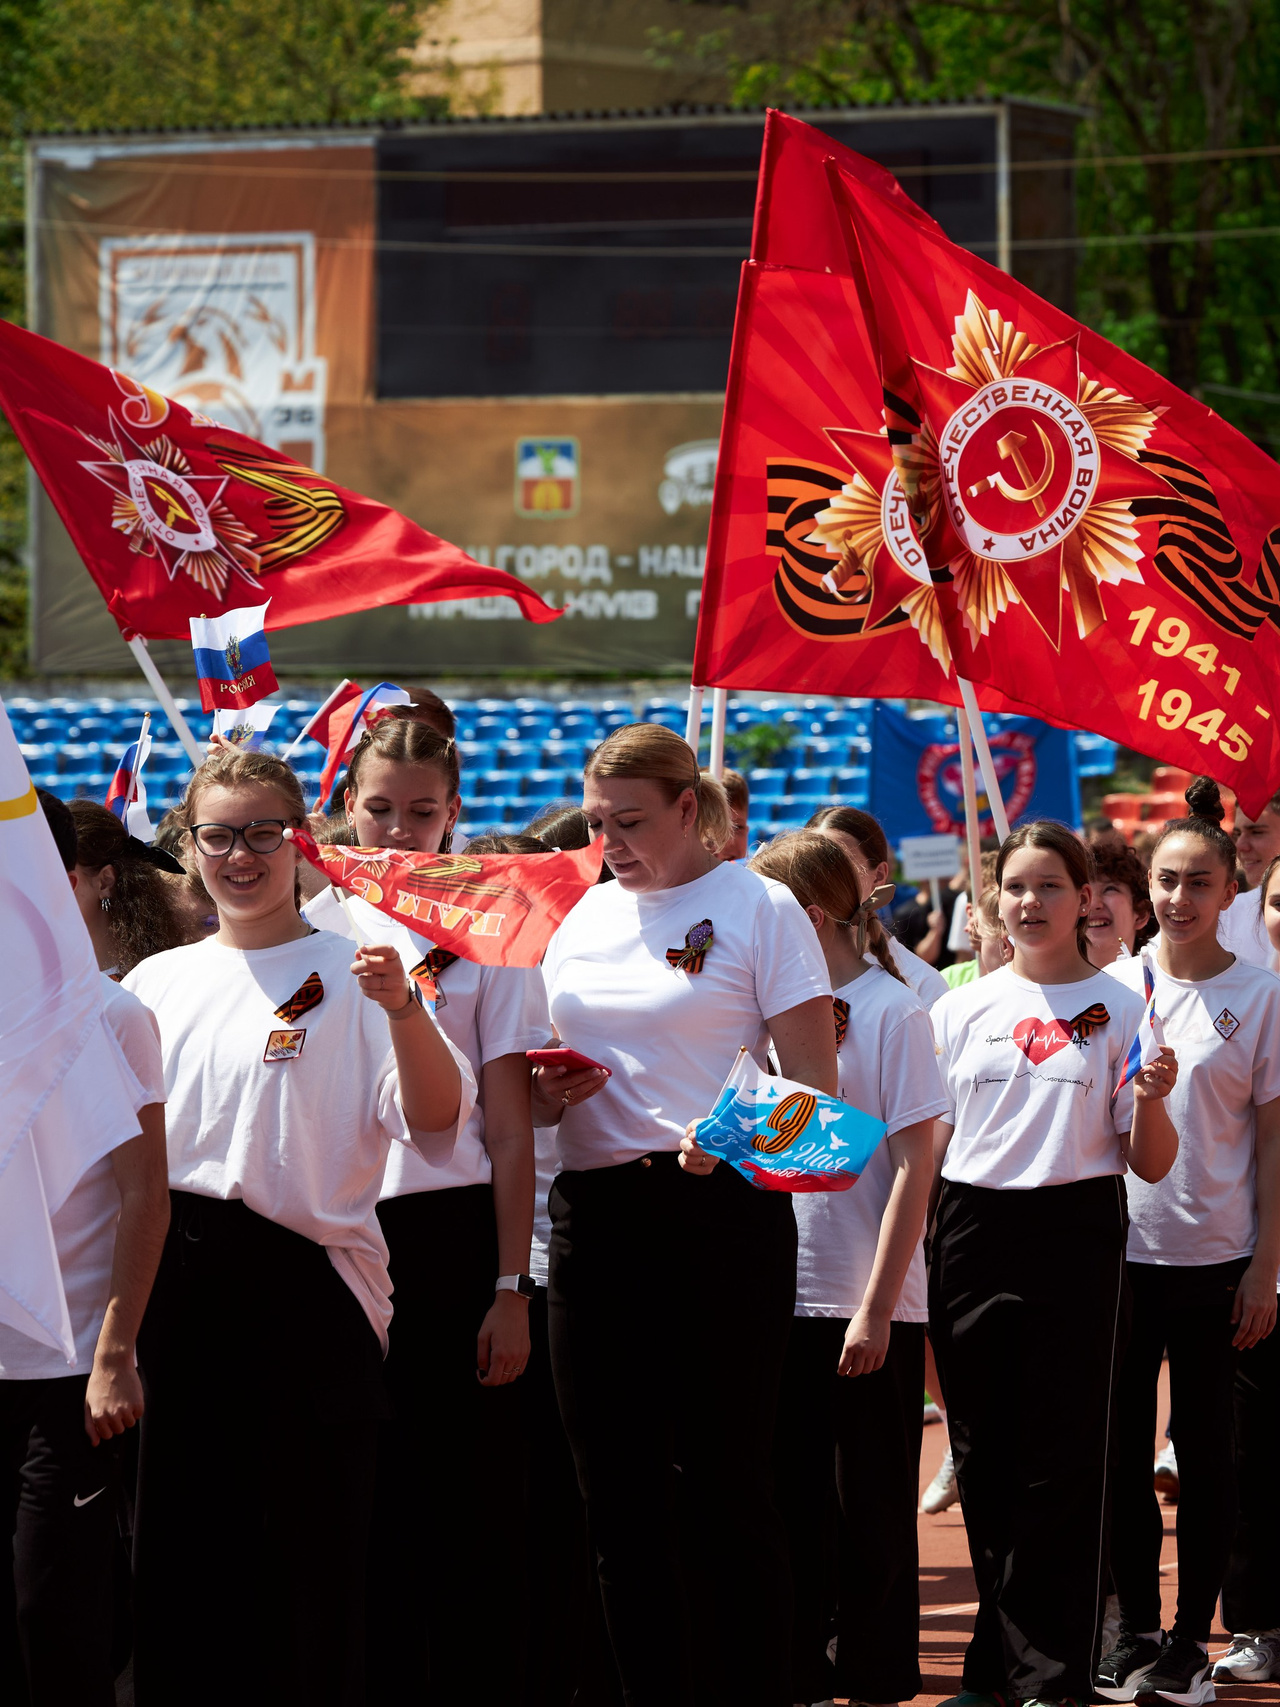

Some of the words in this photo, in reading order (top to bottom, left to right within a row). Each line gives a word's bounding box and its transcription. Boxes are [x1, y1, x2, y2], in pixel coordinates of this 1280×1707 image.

[943, 385, 1094, 528] ОТЕЧЕСТВЕННАЯ
[1137, 678, 1254, 762] 1945
[750, 1091, 818, 1155] 9
